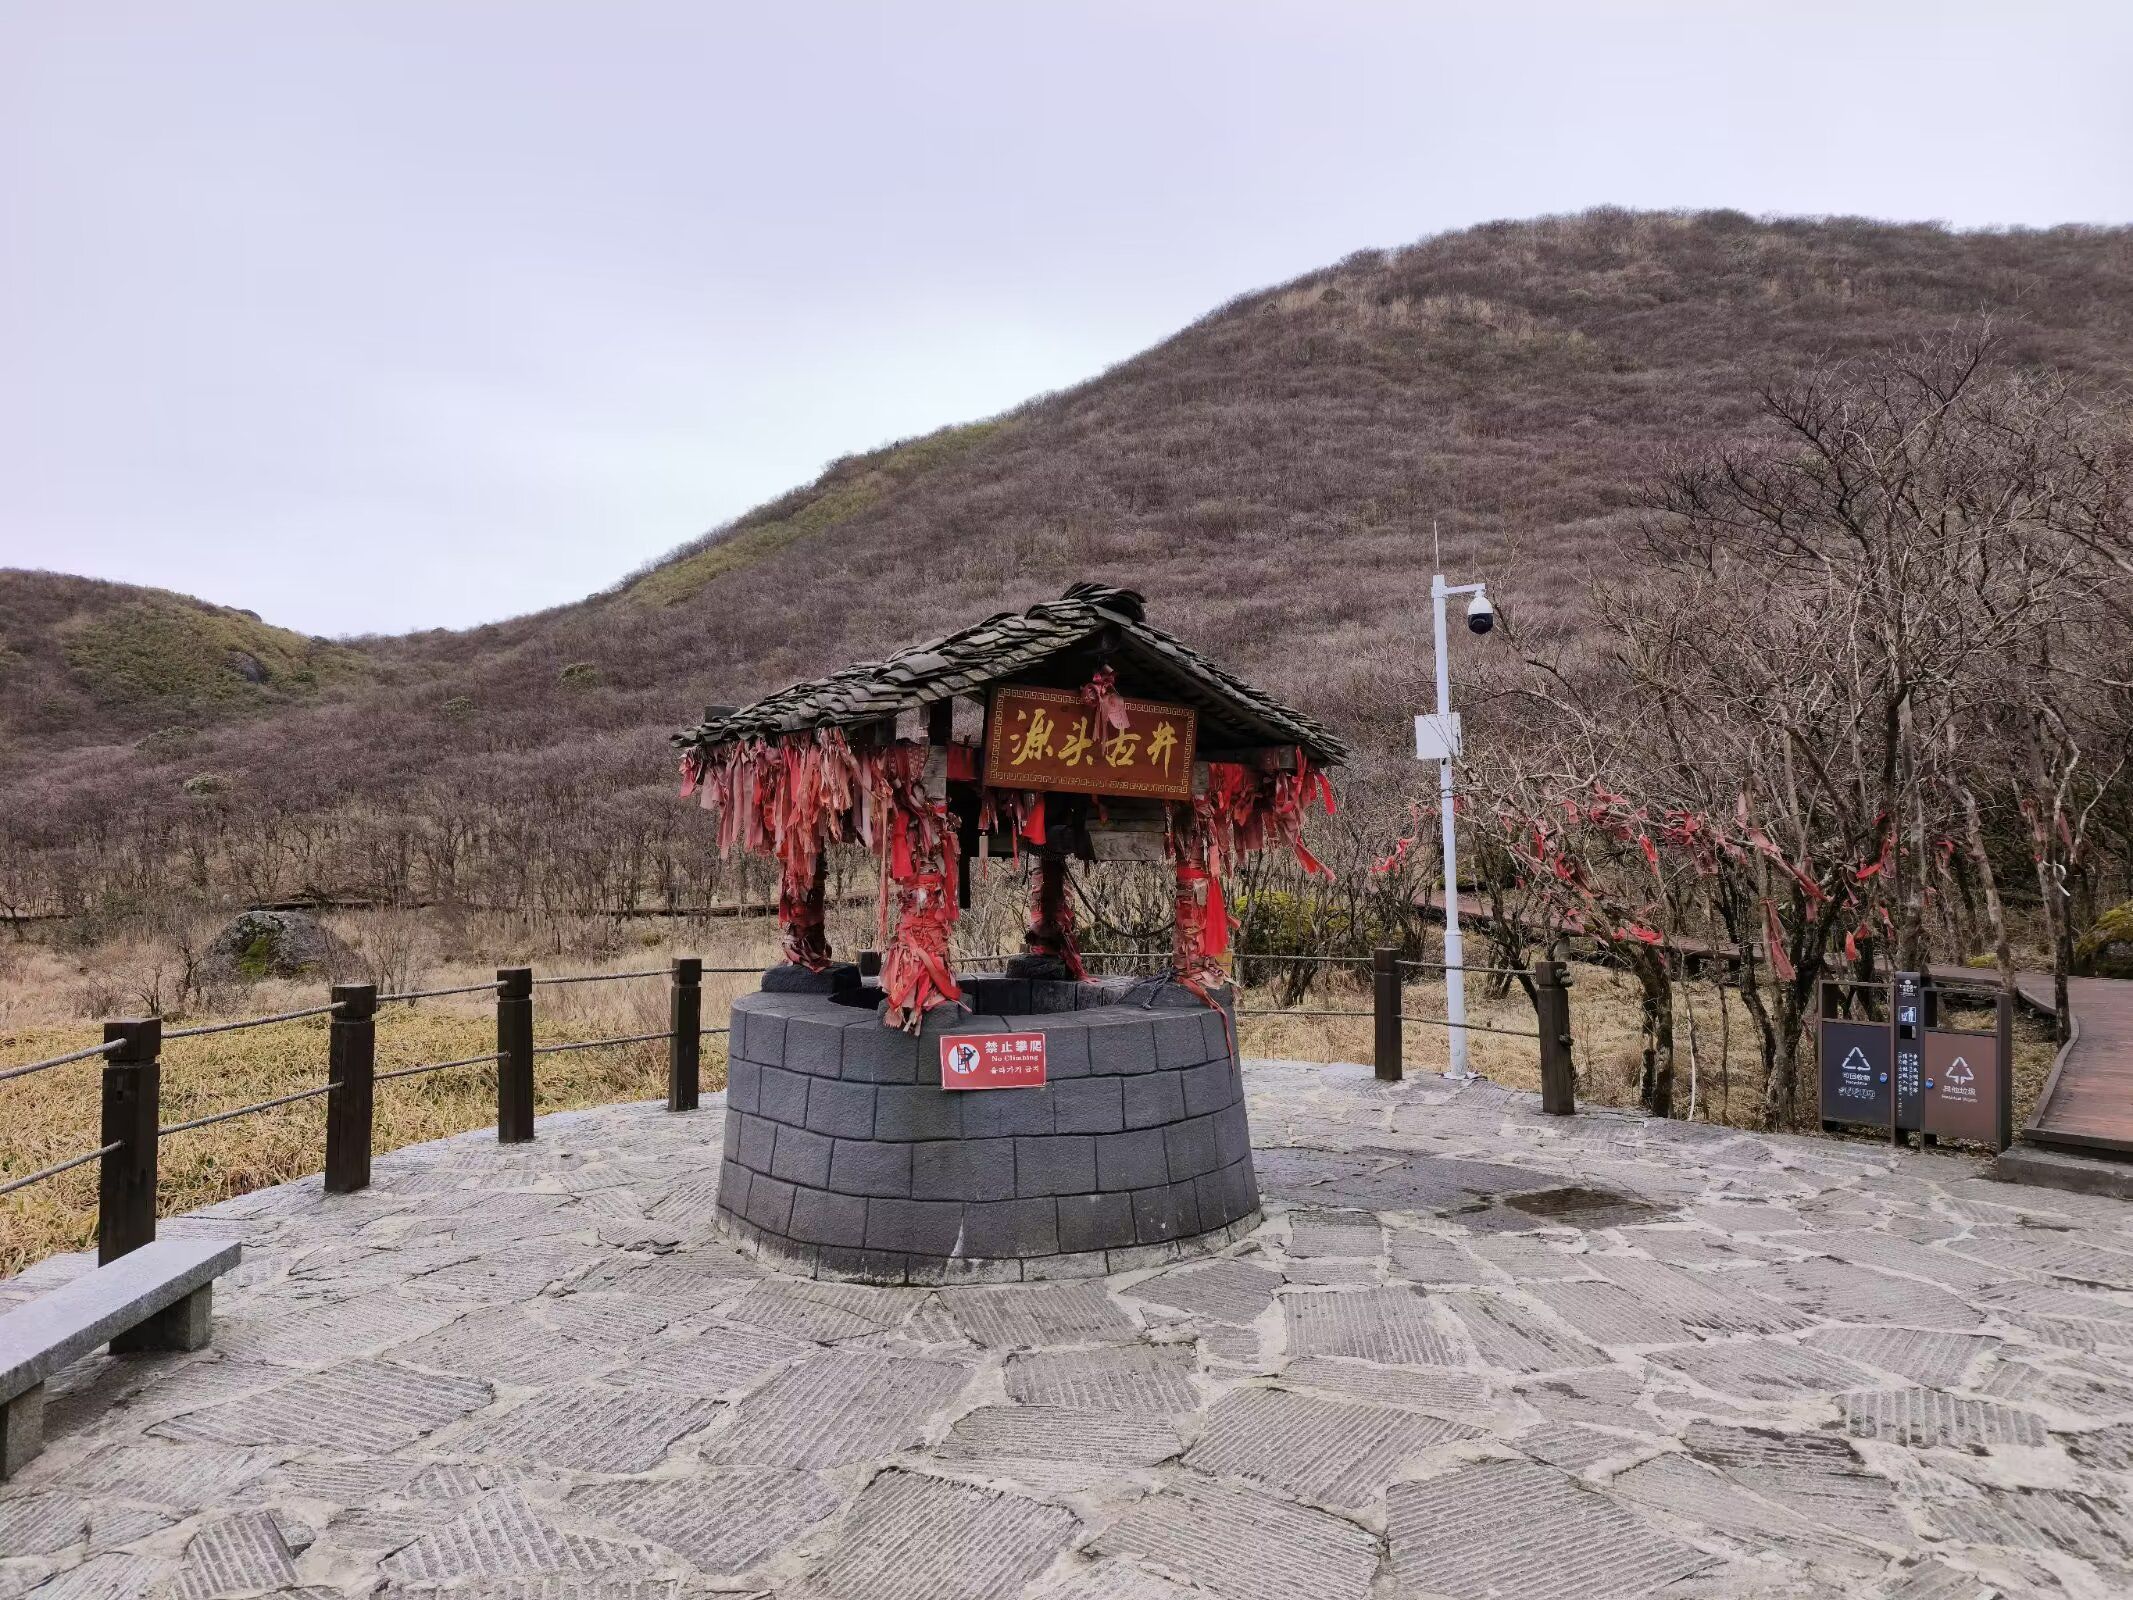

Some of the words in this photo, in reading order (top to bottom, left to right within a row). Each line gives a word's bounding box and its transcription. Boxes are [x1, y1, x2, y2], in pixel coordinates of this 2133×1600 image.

[1010, 708, 1178, 778] 源头古井
[985, 1040, 1042, 1053] 禁止攀爬
[1843, 1072, 1870, 1081] 可回收物
[1942, 1085, 1976, 1095] 其他垃圾
